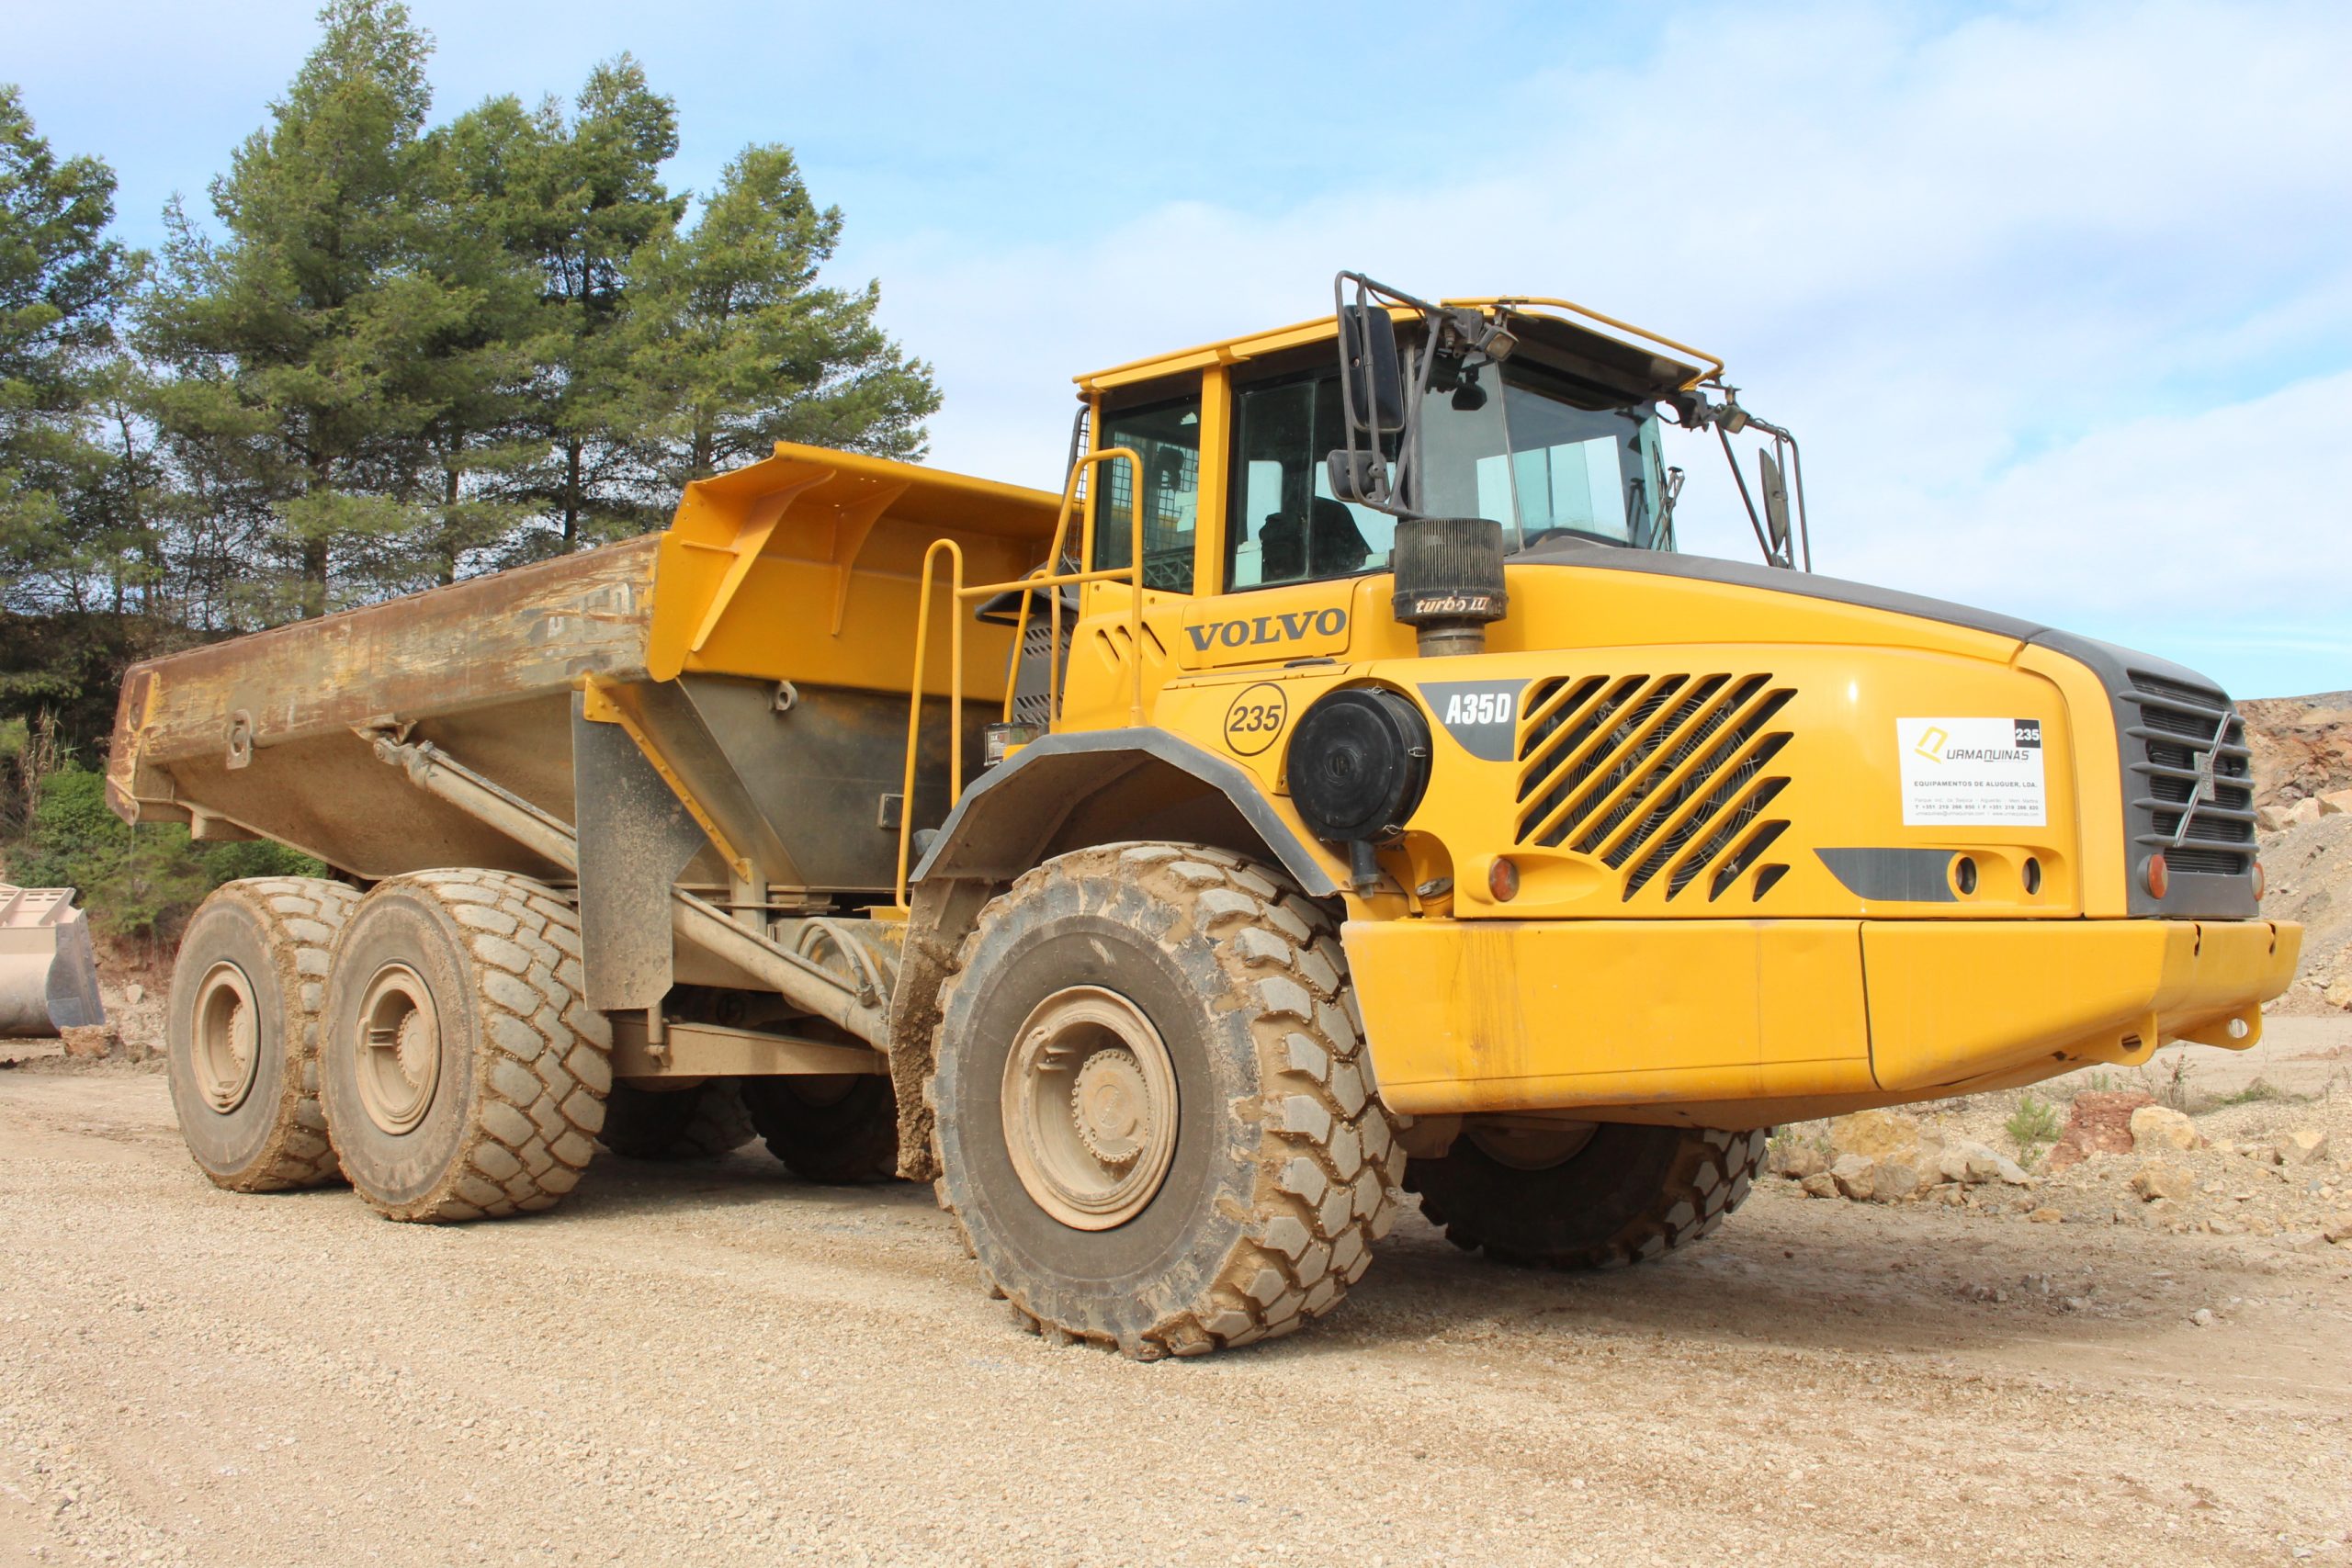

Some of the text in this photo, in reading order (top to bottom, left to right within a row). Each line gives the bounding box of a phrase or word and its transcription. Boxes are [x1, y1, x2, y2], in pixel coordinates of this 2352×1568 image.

[1416, 597, 1466, 614] turbo
[1184, 608, 1347, 651] VOLVO
[1229, 705, 1282, 732] 235
[1445, 693, 1511, 725] A35D
[2015, 728, 2040, 741] 235
